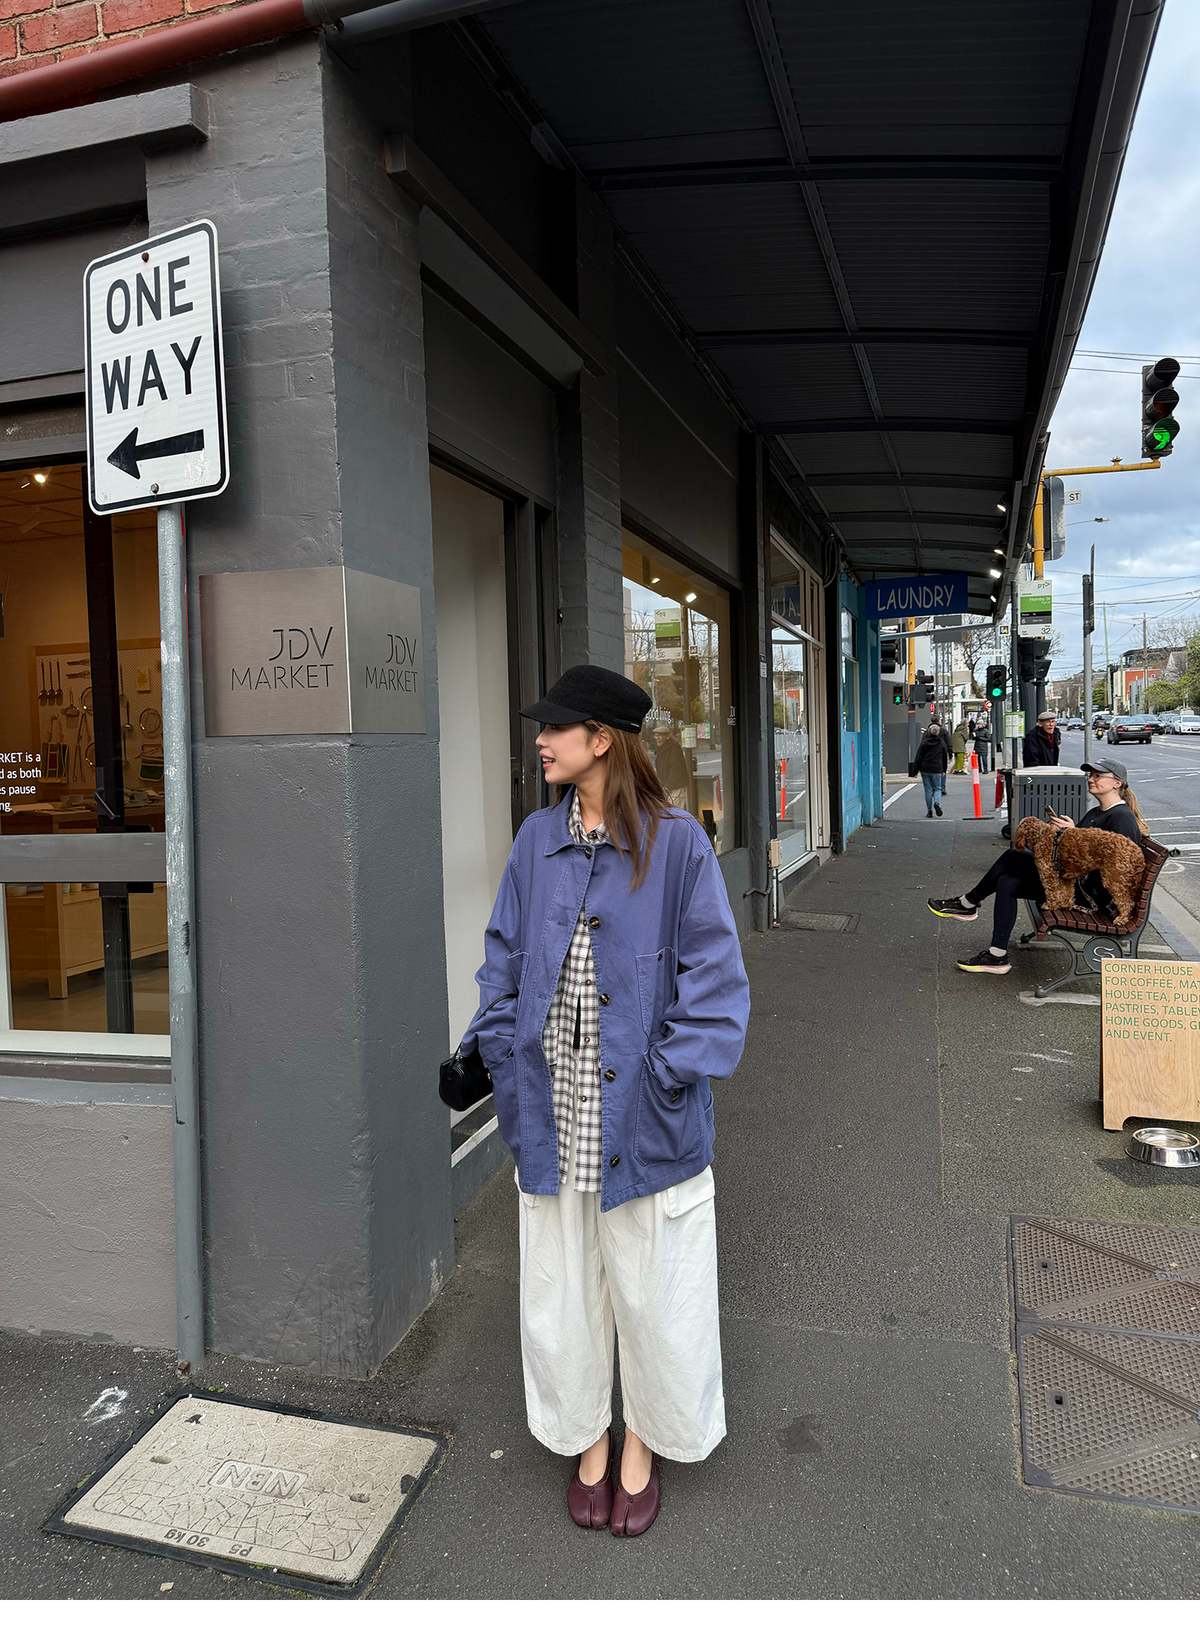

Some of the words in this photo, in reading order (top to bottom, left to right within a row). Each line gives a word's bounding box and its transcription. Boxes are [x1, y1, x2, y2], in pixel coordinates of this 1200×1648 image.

[106, 255, 194, 335] ONE
[101, 335, 202, 414] WAY
[1069, 492, 1080, 501] ST
[877, 584, 955, 612] LAUNDRY
[269, 626, 333, 661] JDV
[386, 633, 417, 666] JDV
[231, 664, 334, 691] MARKET
[365, 666, 418, 693] MARKET
[25, 752, 33, 763] is
[35, 753, 42, 763] a
[7, 770, 17, 779] as
[19, 767, 42, 779] both
[8, 785, 36, 796] pause
[1104, 963, 1151, 974] CORNER
[1154, 965, 1193, 976] HOUSE
[1105, 976, 1127, 986] FOR
[1129, 978, 1176, 989] COFFEE,
[1105, 989, 1143, 1000] HOUSE
[1146, 991, 1170, 1003] TEA,
[1173, 992, 1200, 1003] PUD
[1105, 1003, 1159, 1015] PASTRIES,
[1162, 1005, 1200, 1017] TABLE
[1105, 1016, 1140, 1026] HOME
[1142, 1018, 1186, 1030] GOODS,
[1105, 1029, 1131, 1039] AND
[1133, 1030, 1173, 1042] EVENT.
[217, 1465, 300, 1499] NBN
[163, 1528, 186, 1543] kg
[186, 1534, 210, 1547] 30
[228, 1543, 254, 1557] P5
